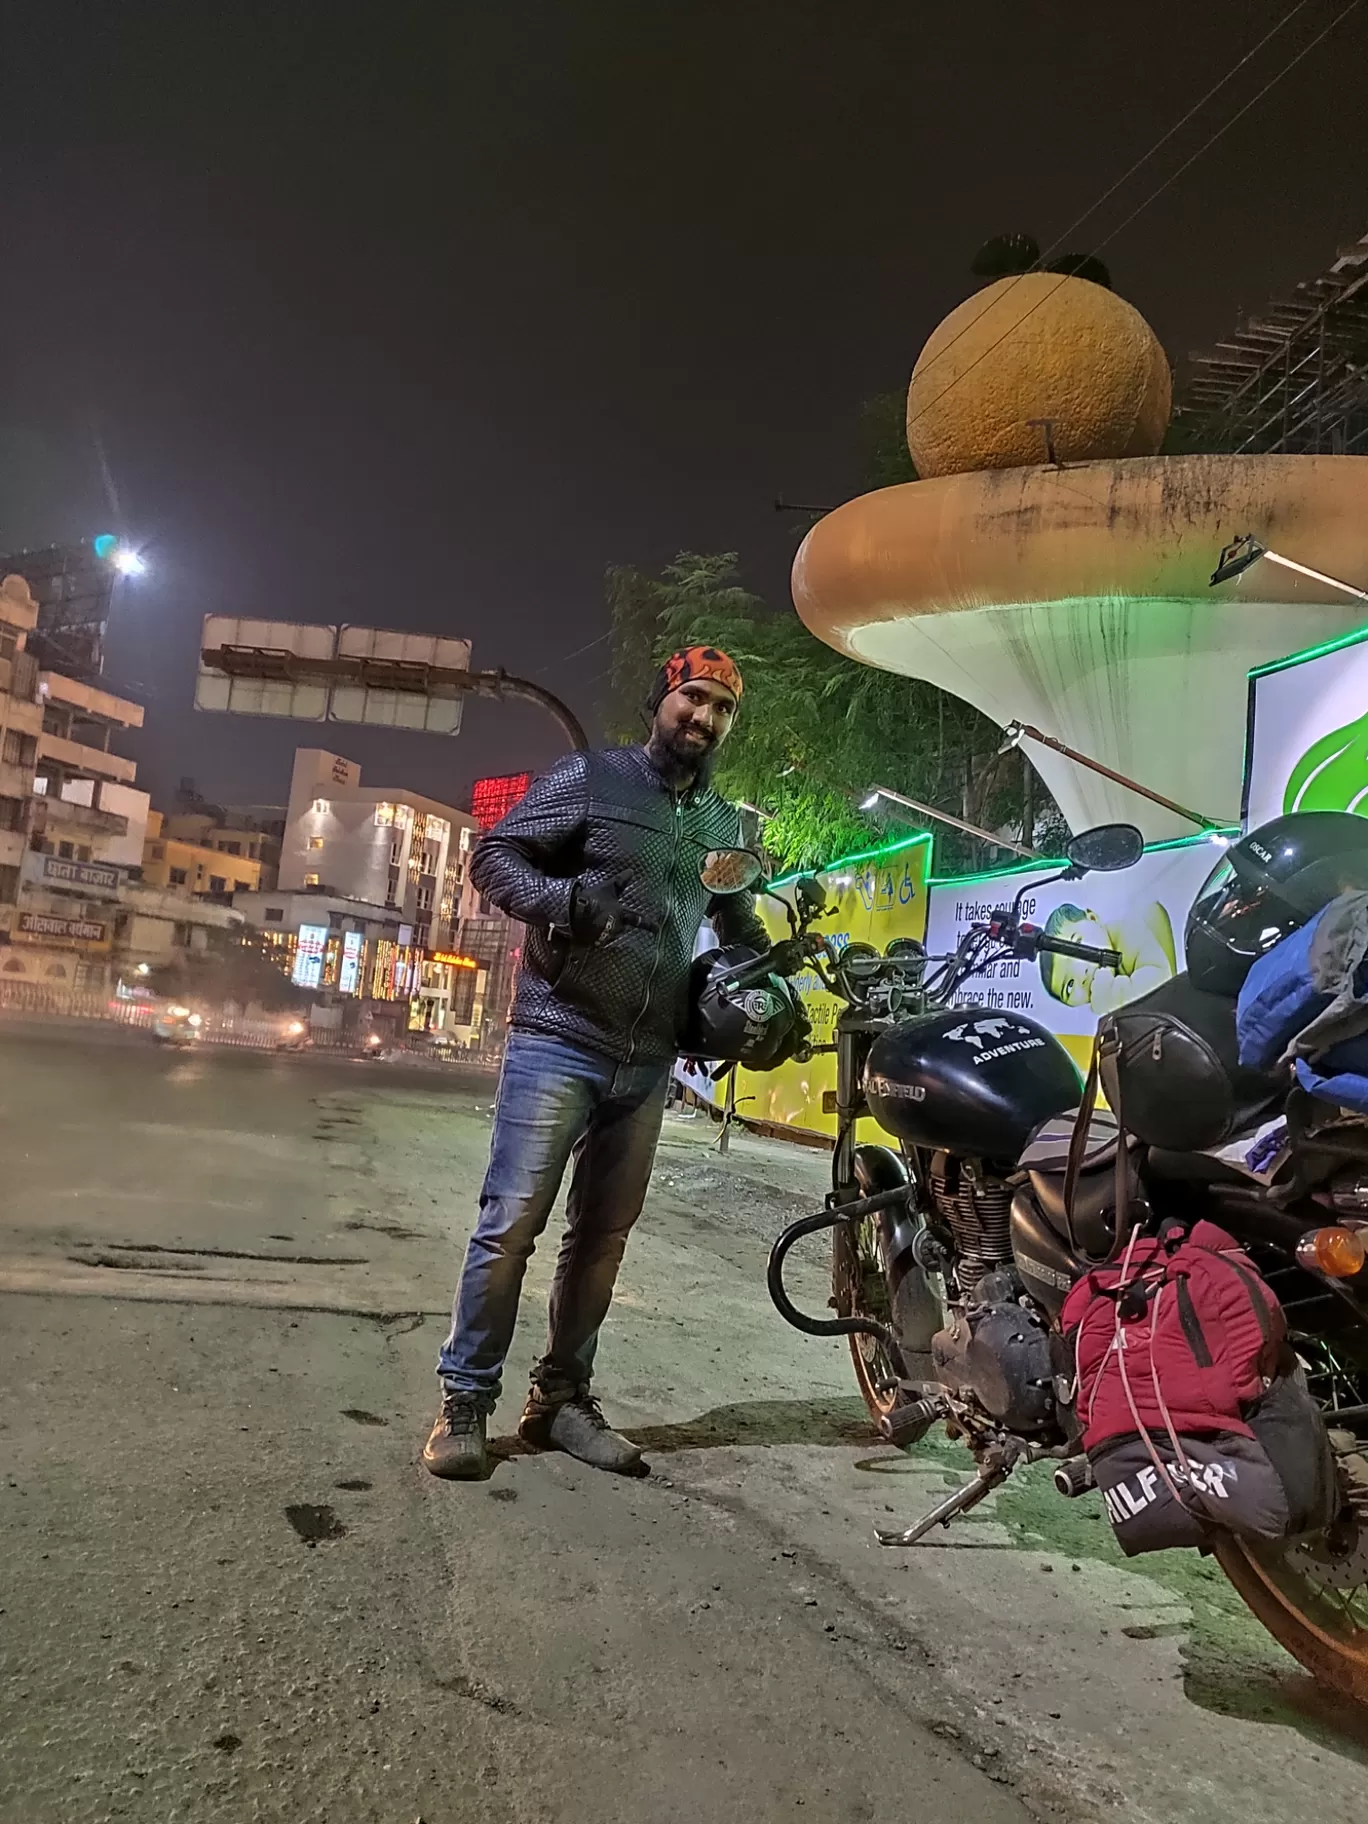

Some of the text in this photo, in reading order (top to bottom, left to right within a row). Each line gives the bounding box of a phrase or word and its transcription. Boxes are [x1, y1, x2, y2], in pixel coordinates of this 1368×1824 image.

[1250, 841, 1272, 863] OSCAR
[955, 902, 963, 921] It
[965, 900, 992, 920] takes
[1000, 958, 1020, 978] and
[948, 987, 1034, 1009] mbrace the new.
[972, 1037, 1046, 1065] ADVENTURE
